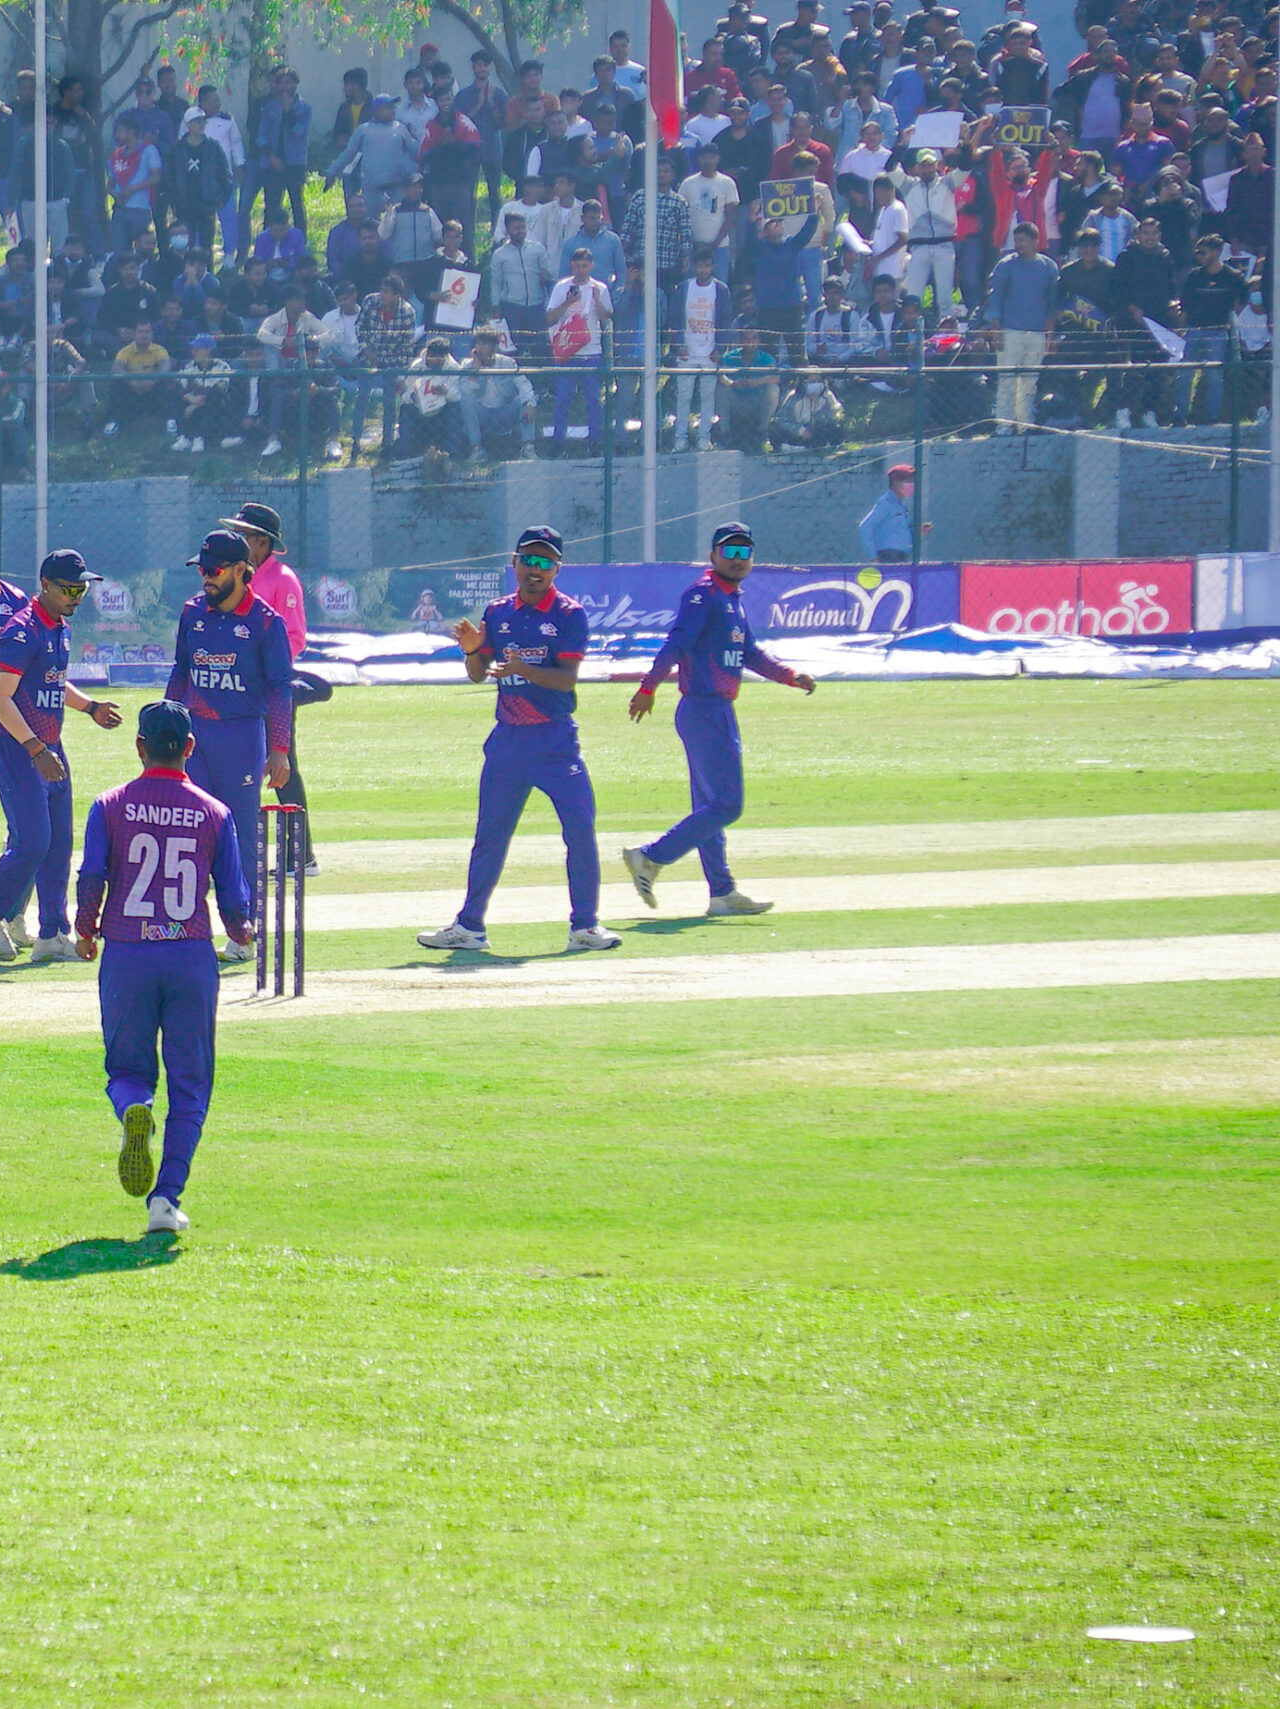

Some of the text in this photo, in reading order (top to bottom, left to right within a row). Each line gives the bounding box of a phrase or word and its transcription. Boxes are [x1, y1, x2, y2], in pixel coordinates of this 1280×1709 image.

[1001, 124, 1045, 143] OUT
[767, 194, 810, 217] OUT
[451, 277, 466, 296] 6
[102, 591, 125, 603] Surf
[326, 590, 350, 603] Surf
[769, 603, 860, 628] National
[193, 653, 237, 666] Second
[190, 668, 246, 692] NEPAL
[125, 803, 206, 828] SANDEEP
[123, 832, 198, 921] 25
